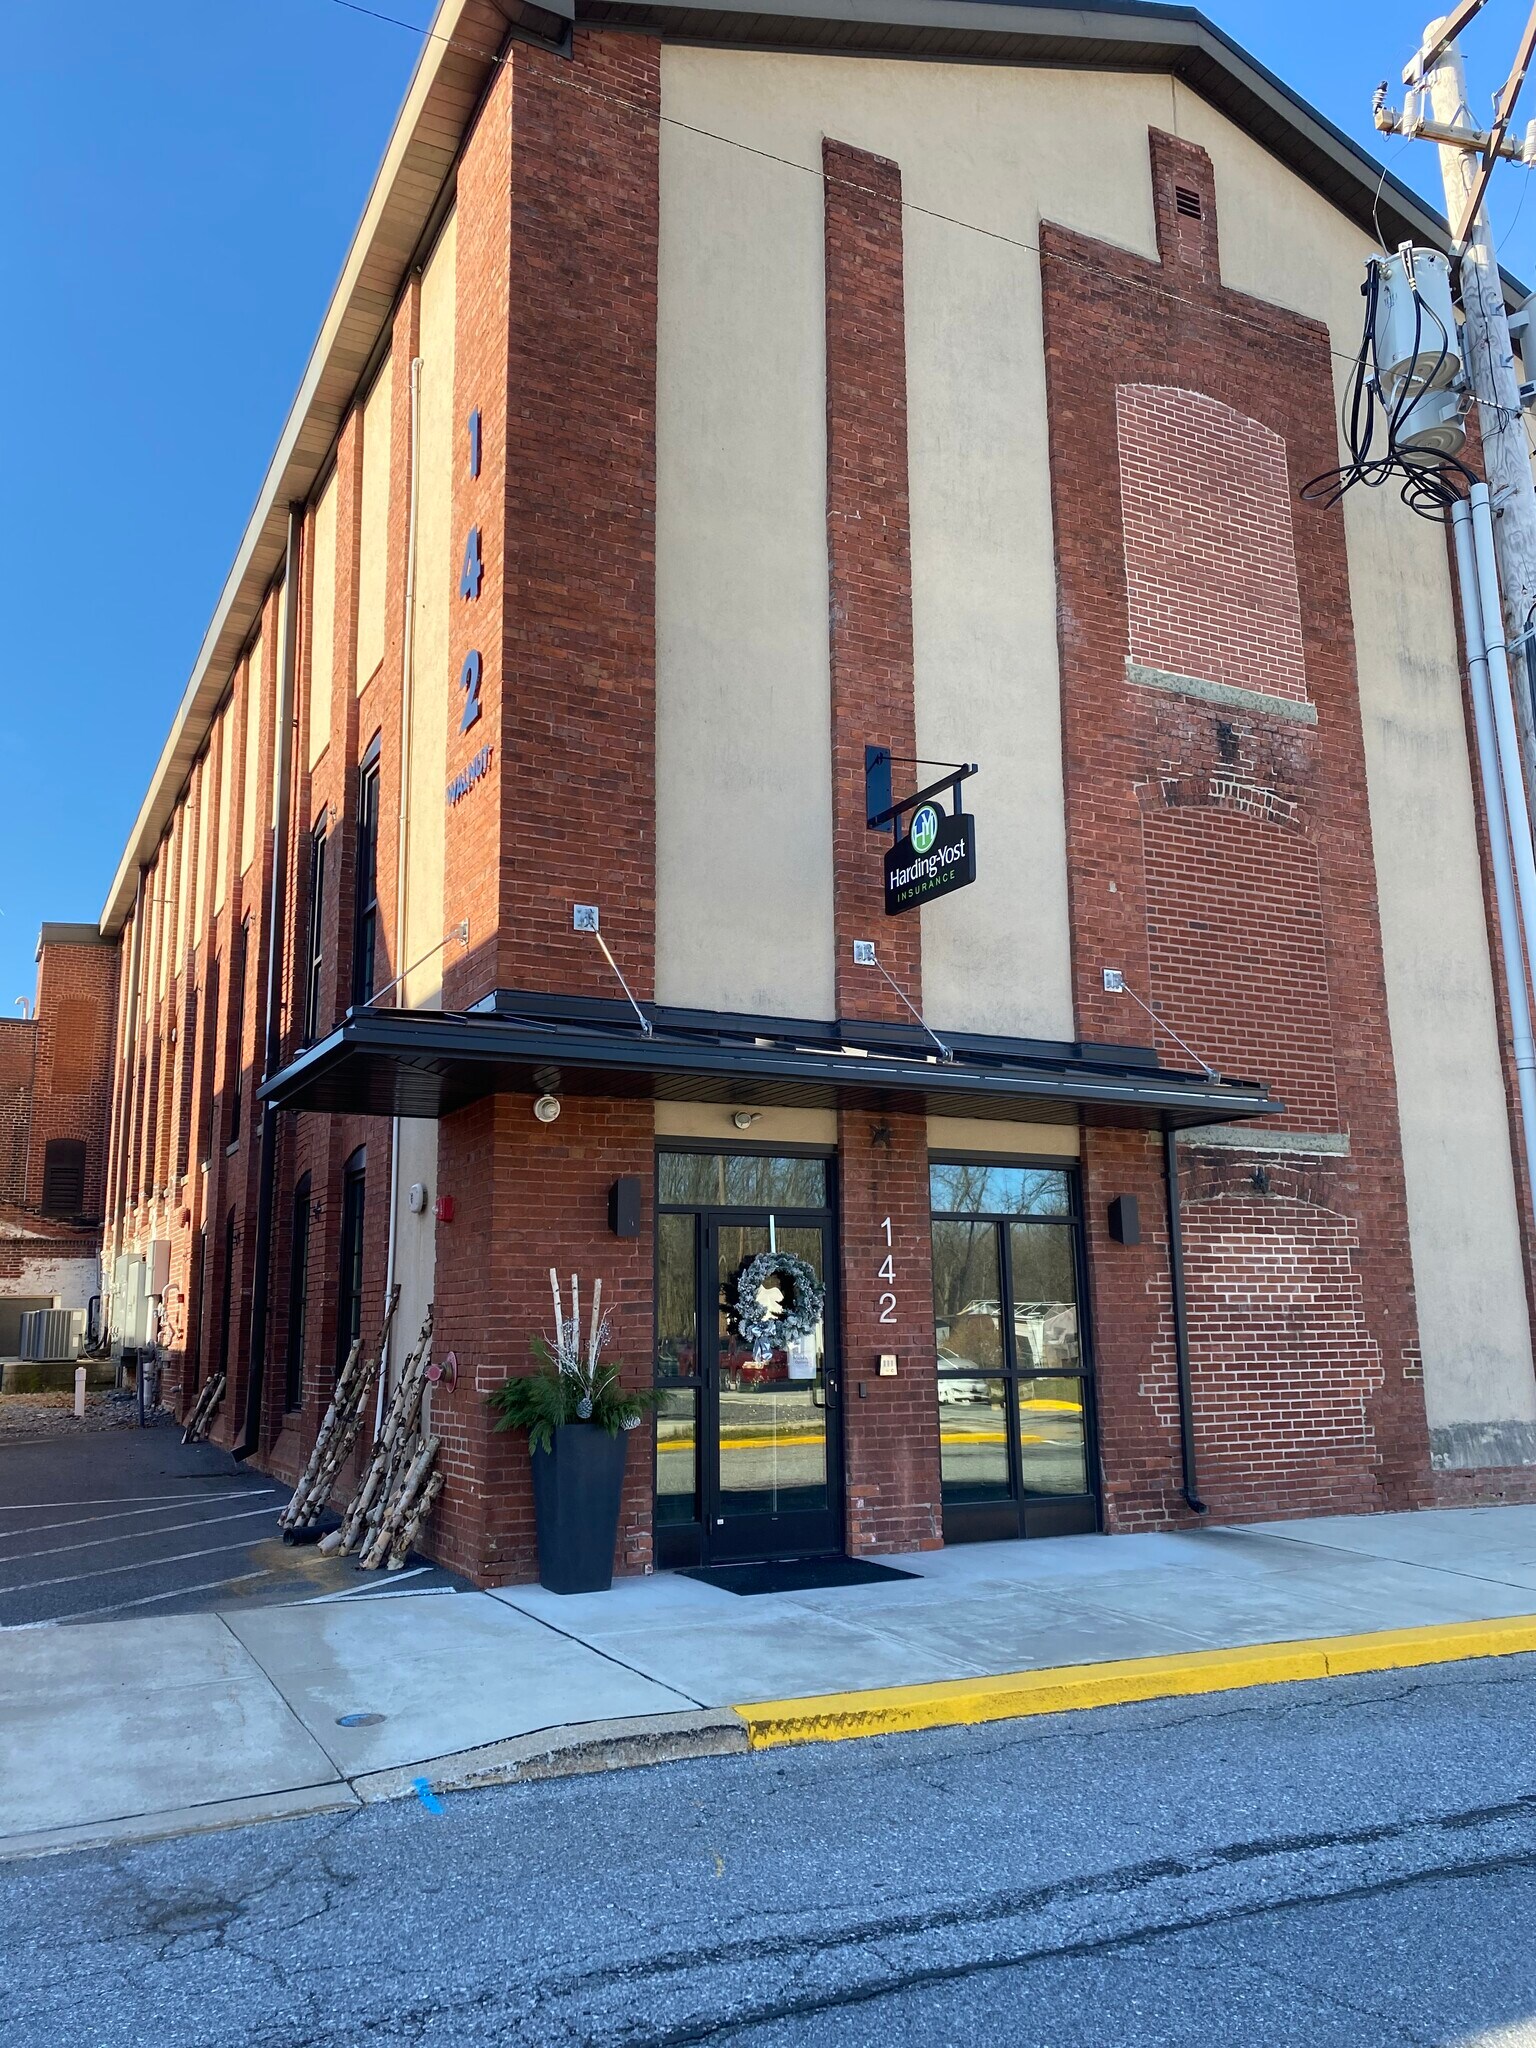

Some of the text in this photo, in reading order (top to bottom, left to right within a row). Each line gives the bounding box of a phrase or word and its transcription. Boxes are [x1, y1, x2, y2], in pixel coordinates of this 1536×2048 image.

[890, 838, 966, 890] Harding-Yost
[897, 869, 956, 903] INSURANCE
[877, 1216, 898, 1324] 142
